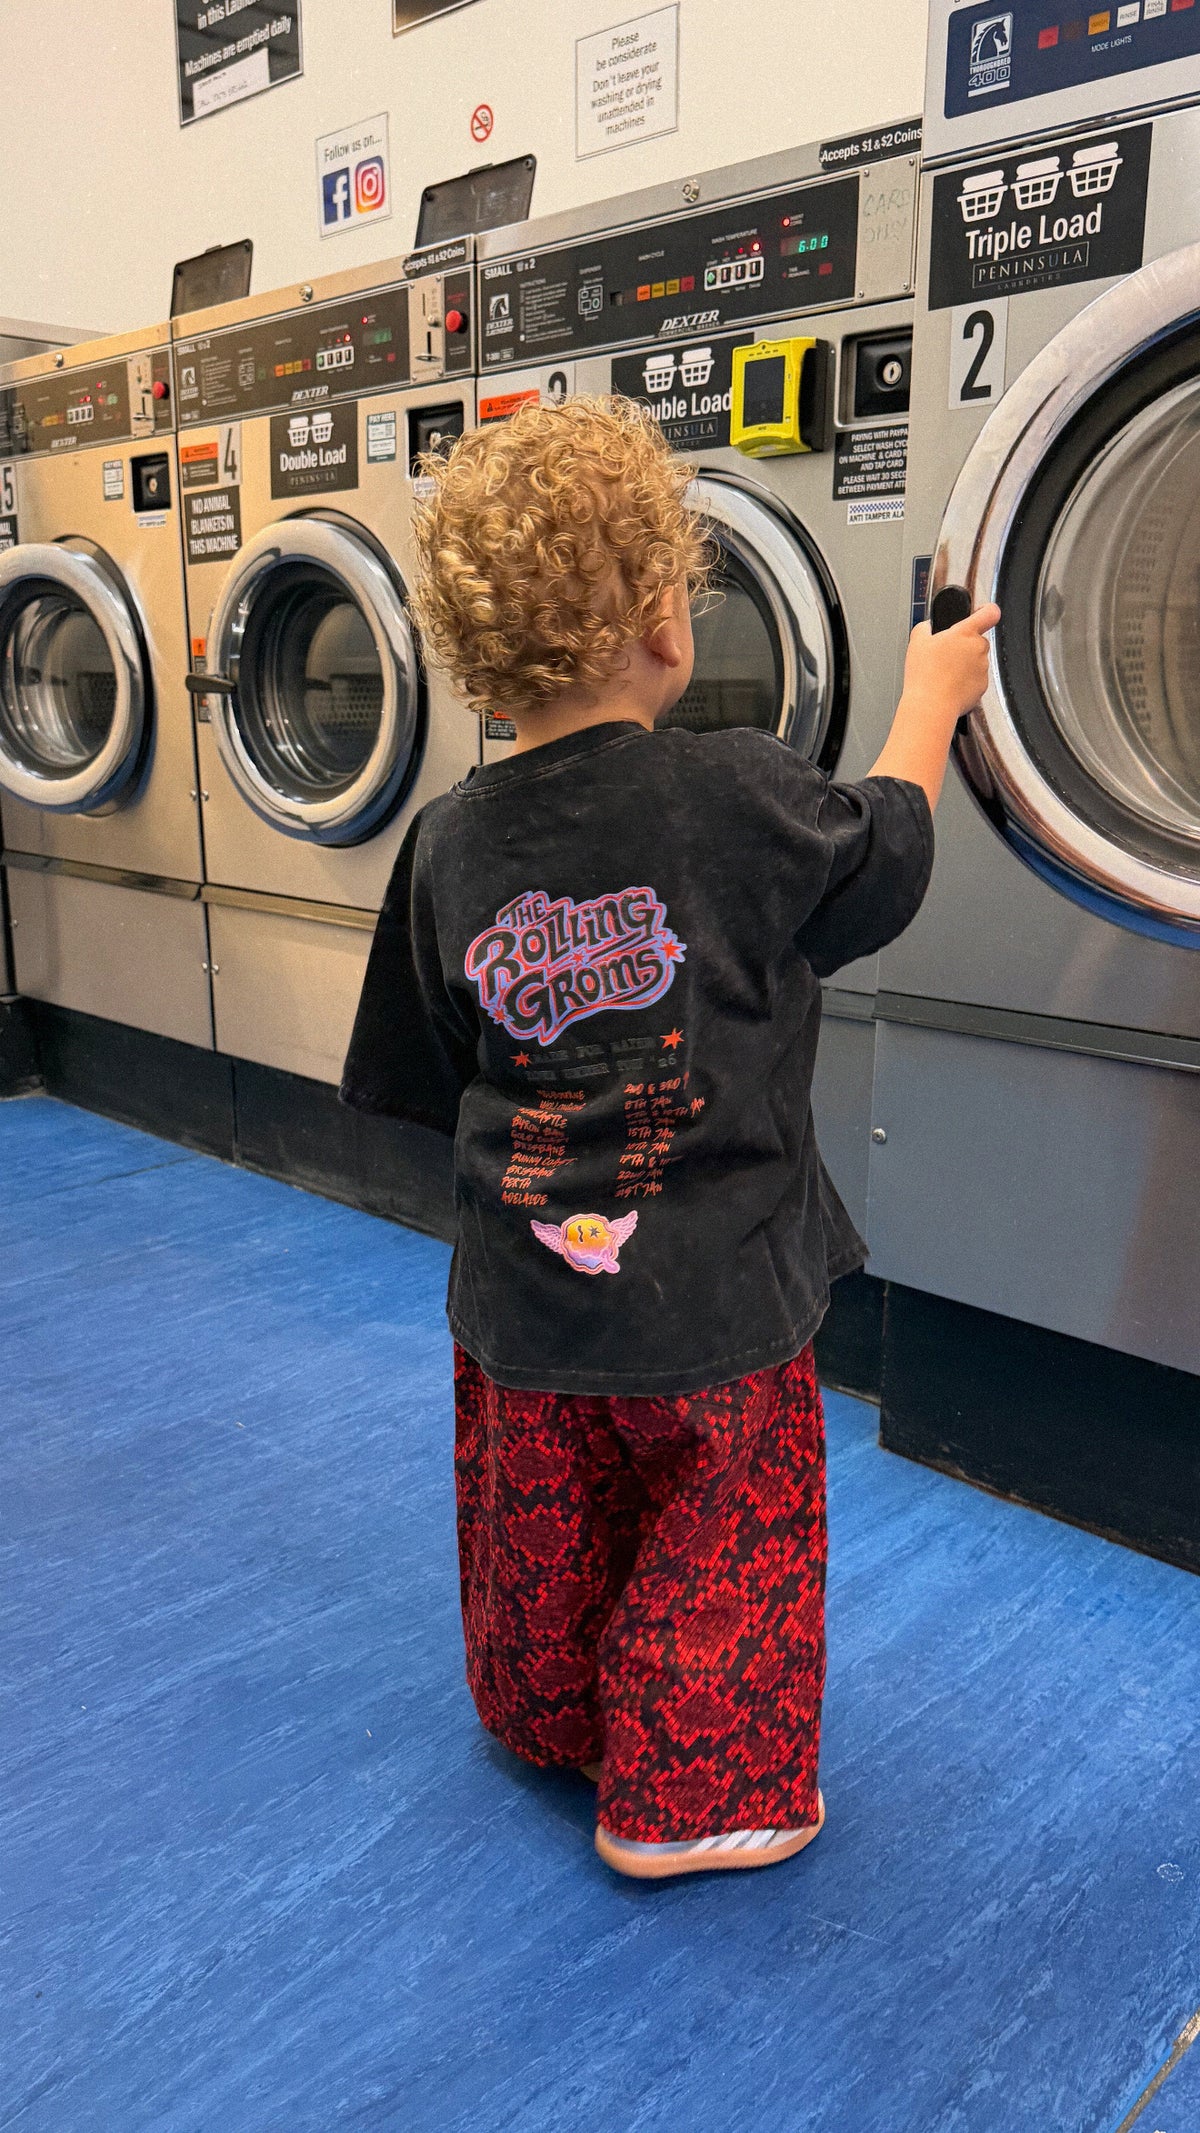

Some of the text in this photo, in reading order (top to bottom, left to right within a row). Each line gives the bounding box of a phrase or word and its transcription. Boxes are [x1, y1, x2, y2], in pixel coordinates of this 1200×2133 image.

[196, 14, 207, 30] in
[208, 4, 225, 25] this
[1119, 10, 1138, 20] RINSE
[184, 16, 292, 77] Machines are emptied daily
[611, 32, 640, 50] Please
[1091, 35, 1132, 53] MODE LIGHTS
[596, 42, 658, 72] be considerate
[617, 68, 640, 84] leave
[640, 61, 660, 80] your
[968, 65, 1011, 88] 400
[591, 76, 663, 109] washing or drying
[597, 96, 655, 123] unattended in
[605, 115, 646, 136] machines
[324, 144, 350, 163] Follow
[352, 140, 362, 152] us
[820, 127, 922, 163] Accepts $1 & $2 Coins
[965, 202, 1103, 260] Triple Load
[448, 246, 466, 259] Coins
[798, 234, 830, 253] 6.00
[484, 264, 513, 280] SMALL
[978, 249, 1083, 282] PENINSULA
[660, 309, 720, 332] DEXTER
[960, 309, 996, 402] 2
[291, 386, 329, 402] DEXTER
[637, 387, 733, 422] ouble Load
[851, 428, 908, 442] PAYING WITH PAYPA
[224, 428, 238, 480] 4
[853, 443, 875, 454] SELECT
[875, 440, 894, 450] WASH
[280, 449, 318, 472] Double
[318, 443, 346, 467] Load
[838, 456, 848, 465] ON
[848, 452, 877, 464] MACHINE
[878, 452, 884, 460] &
[884, 450, 902, 460] CARD
[860, 459, 904, 472] AND TAP CARD
[843, 474, 866, 485] PLEASE
[865, 473, 881, 482] WAIT
[880, 472, 890, 481] 30
[3, 466, 14, 512] 5
[838, 484, 866, 496] BETWEEN
[866, 482, 894, 492] PAYMENT
[192, 494, 231, 514] NO ANIMAL
[190, 514, 234, 536] BLANKETS IN
[849, 514, 864, 524] ANTI
[864, 512, 891, 521] TAMPER
[190, 534, 240, 556] THIS MACHINE
[498, 892, 549, 931] THE
[510, 1129, 534, 1142] GOLD
[626, 1126, 676, 1142] 15TH JAN
[512, 1140, 566, 1157] BRISBANE
[648, 1142, 672, 1155] JAN
[510, 1152, 542, 1166] SUNNY
[506, 1165, 557, 1178] BRISBANE
[500, 1176, 532, 1190] PERTH
[642, 1181, 664, 1198] JAN
[500, 1190, 549, 1208] ADELAIDE
